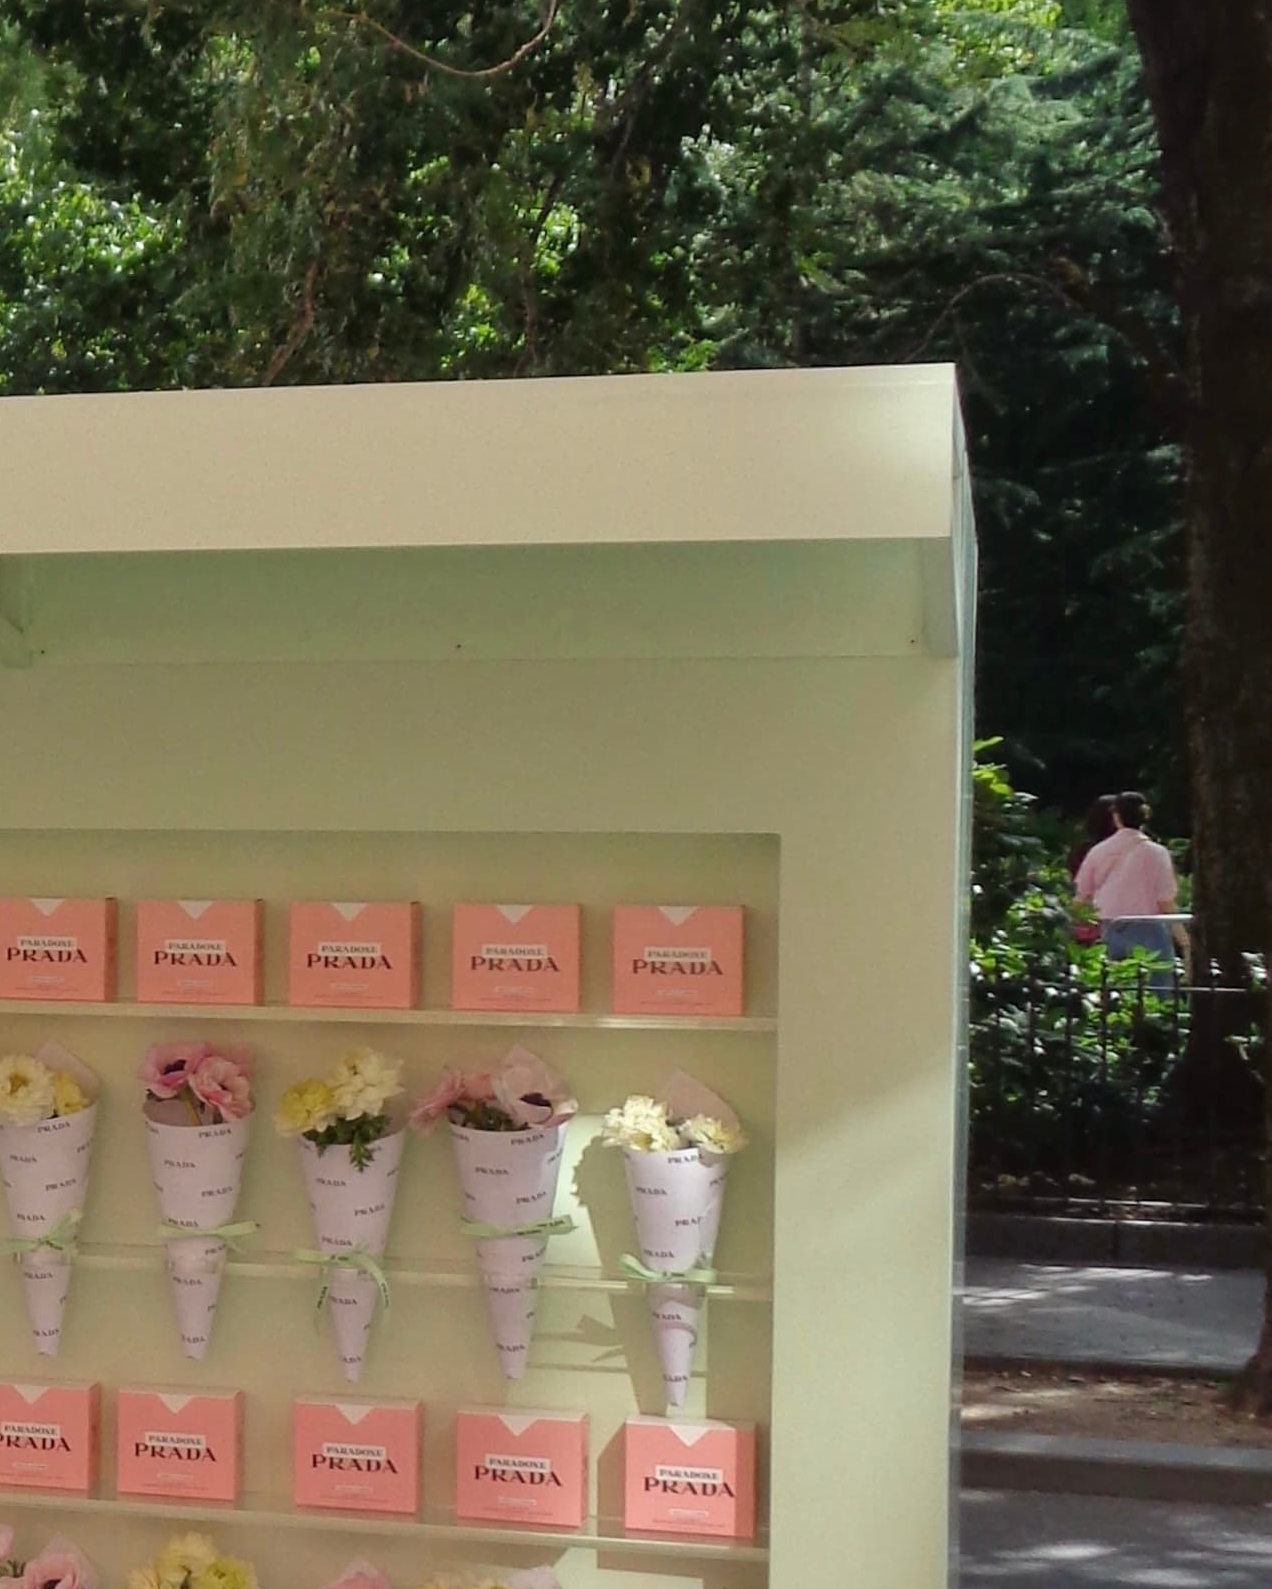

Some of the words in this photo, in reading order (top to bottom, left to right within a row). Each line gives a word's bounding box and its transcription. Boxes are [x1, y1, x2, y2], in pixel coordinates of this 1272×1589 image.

[20, 939, 74, 948] PARADOXE
[168, 942, 221, 951] PARADOXE
[7, 948, 87, 963] PRADA
[154, 951, 237, 967] PRADA
[307, 953, 392, 970] PRADA
[470, 956, 560, 972] PRADA
[632, 959, 723, 976] PRADA
[37, 1122, 70, 1133] PRADA
[198, 1129, 231, 1138] PRADA
[511, 1134, 544, 1146] PRADA
[10, 1154, 37, 1163] PRADA
[668, 1154, 703, 1164] PRADA
[164, 1161, 195, 1169] PRADA
[475, 1167, 509, 1175] PRADA
[45, 1179, 76, 1191] PRADA
[636, 1186, 667, 1195] PRADA
[201, 1186, 232, 1197] PRADA
[354, 1205, 385, 1216] PRADA
[322, 1237, 352, 1246] PRADA
[4, 1425, 57, 1435] PARADOXE
[148, 1435, 203, 1446] PARADOXE
[135, 1443, 217, 1462] PRADA
[326, 1446, 383, 1458] PARADOXE
[312, 1454, 398, 1474] PRADA
[489, 1458, 547, 1470] PARADOXE
[475, 1466, 563, 1486] PRADA
[659, 1469, 719, 1480] PARADOXE
[644, 1477, 735, 1498] PRADA
